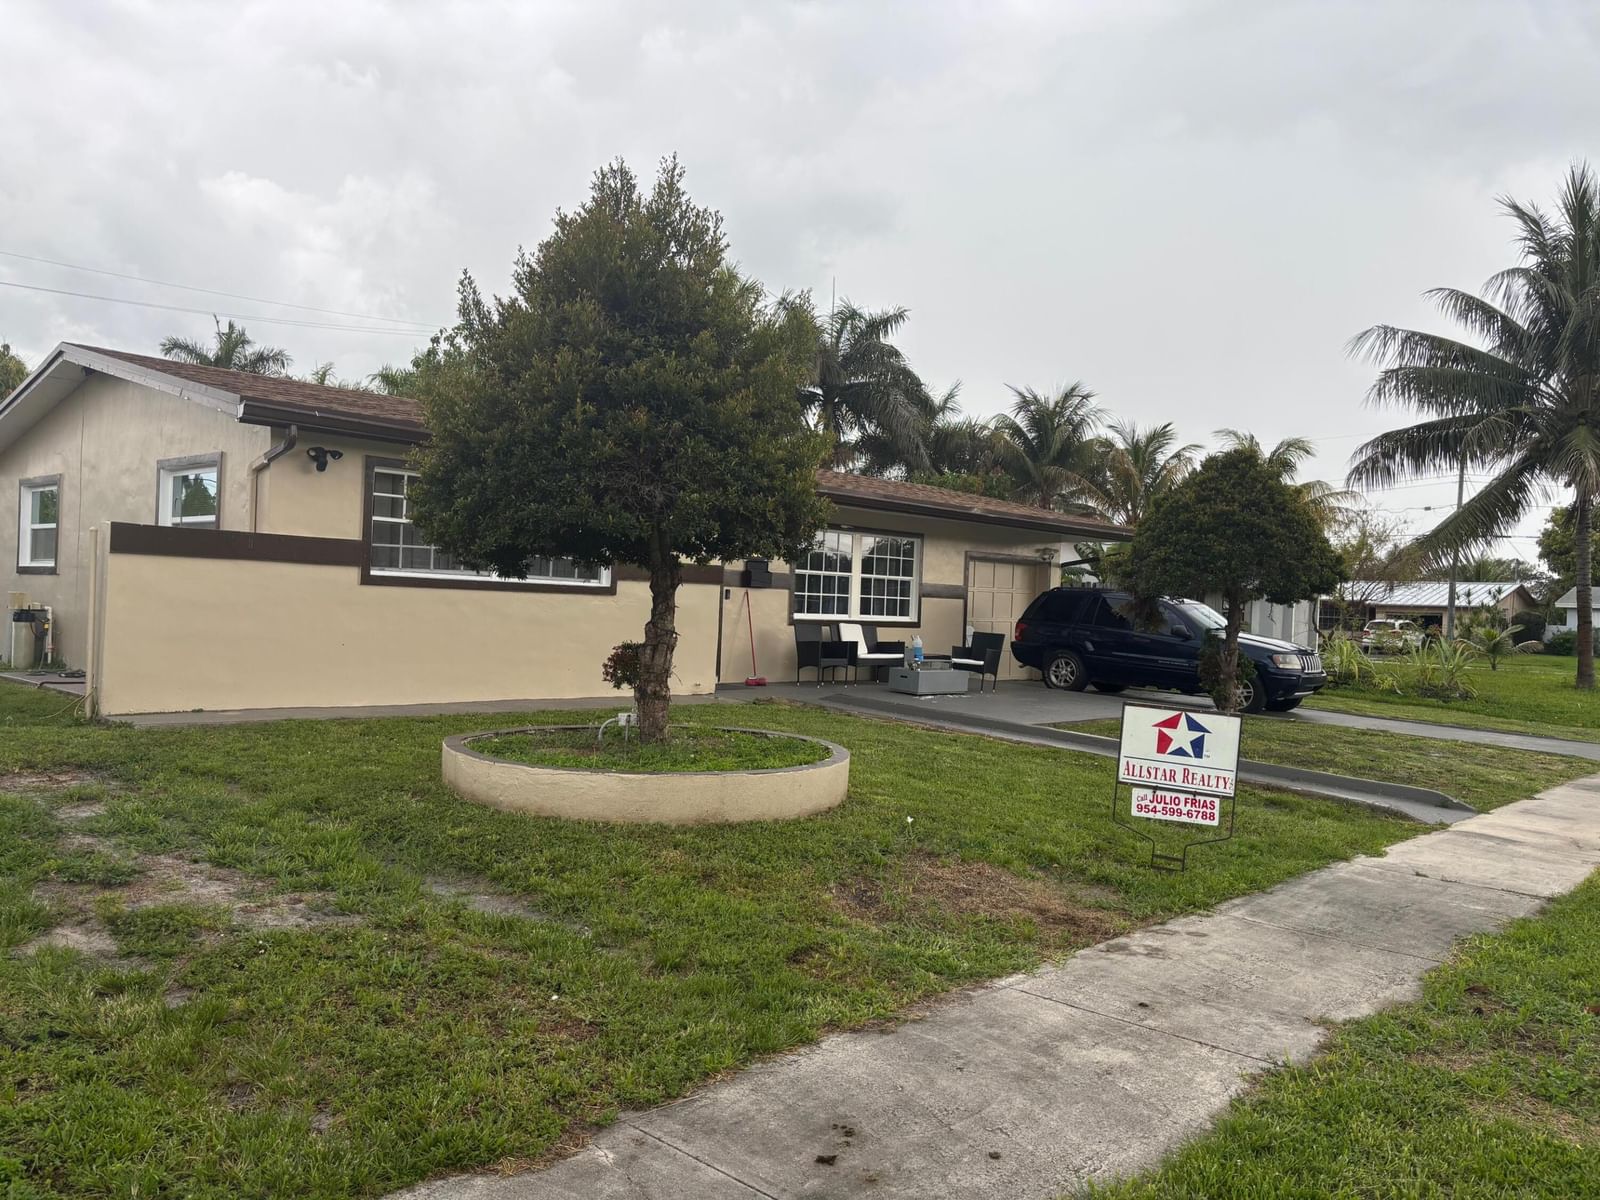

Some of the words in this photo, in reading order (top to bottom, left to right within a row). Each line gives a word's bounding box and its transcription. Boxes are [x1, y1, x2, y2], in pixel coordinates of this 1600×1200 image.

[1123, 760, 1177, 783] ALLSTAR
[1182, 768, 1230, 790] REALTY
[1149, 794, 1181, 806] JULIO
[1184, 798, 1216, 810] FRIAS
[1136, 804, 1215, 821] 954-599-6788
